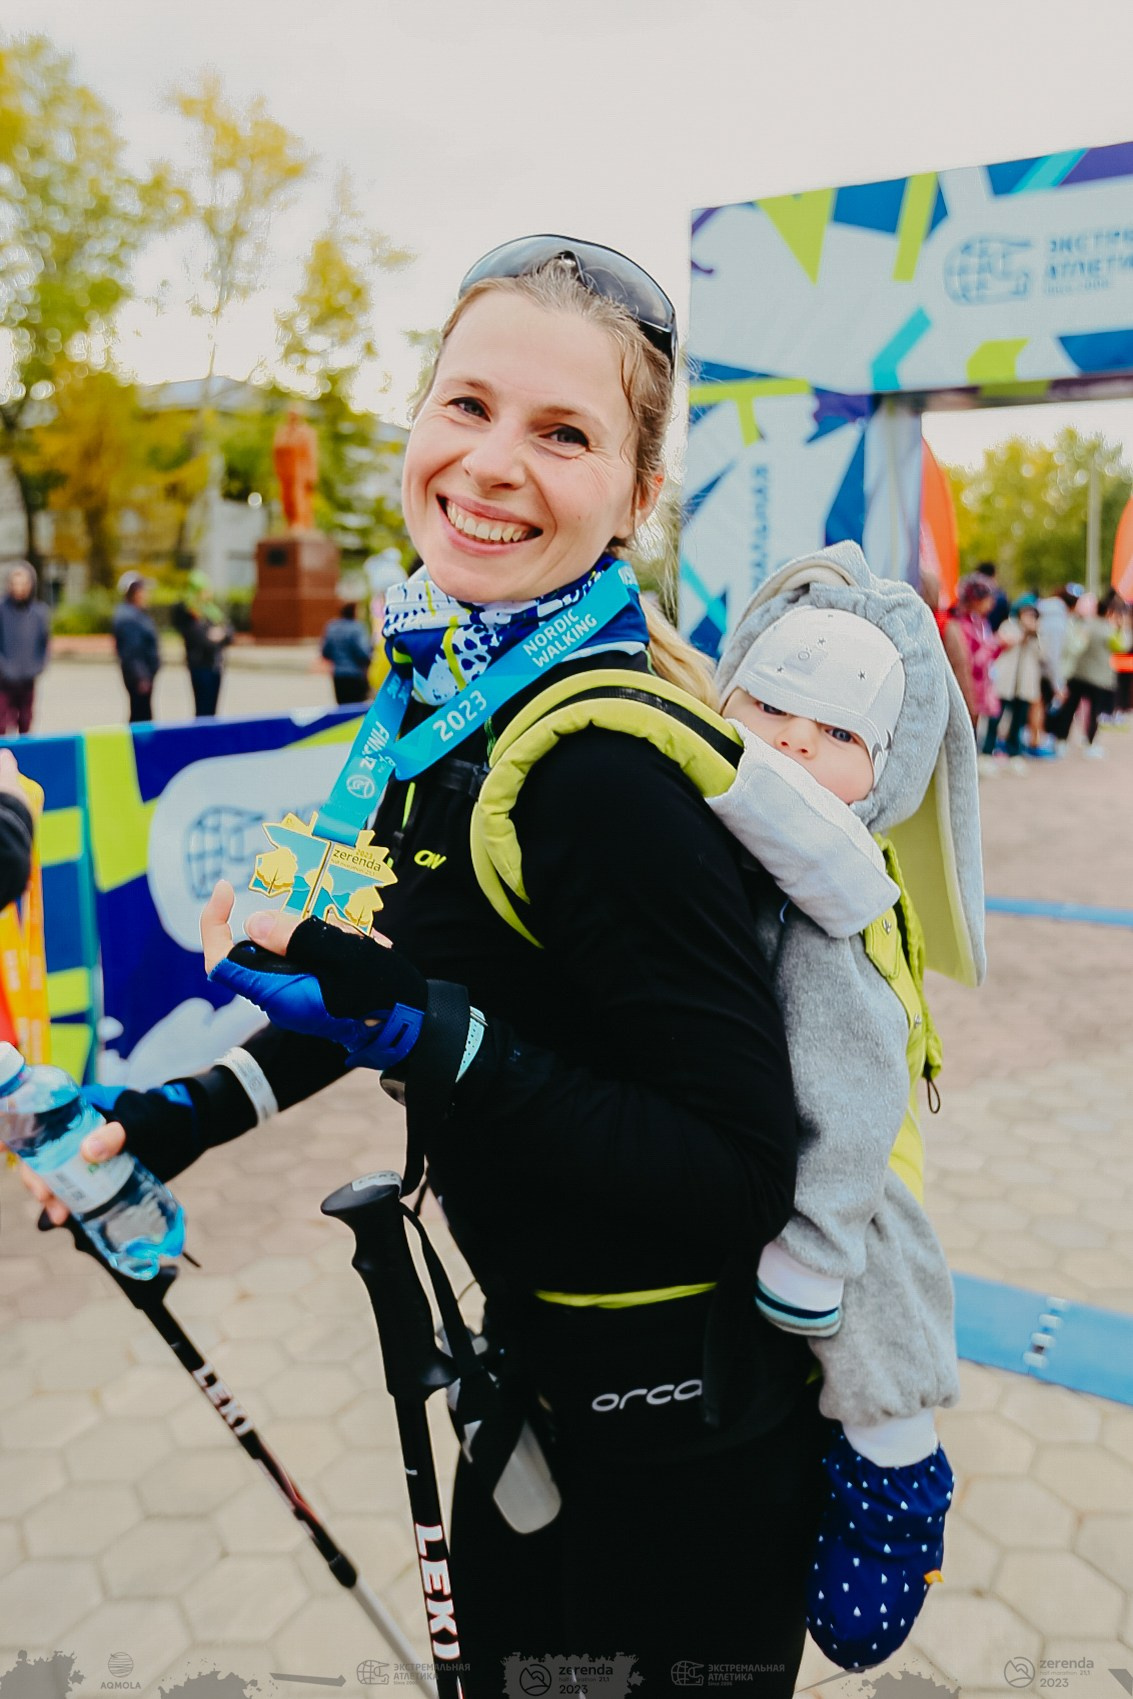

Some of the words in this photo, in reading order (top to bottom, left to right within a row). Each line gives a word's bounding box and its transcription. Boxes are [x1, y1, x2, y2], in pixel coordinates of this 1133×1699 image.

[523, 608, 580, 657] NORDIC
[532, 613, 599, 668] WALKING
[432, 689, 487, 743] 2023
[332, 848, 382, 873] zerenda
[192, 1362, 254, 1437] LEKI
[592, 1378, 703, 1412] orca
[415, 1522, 461, 1661] LEKI
